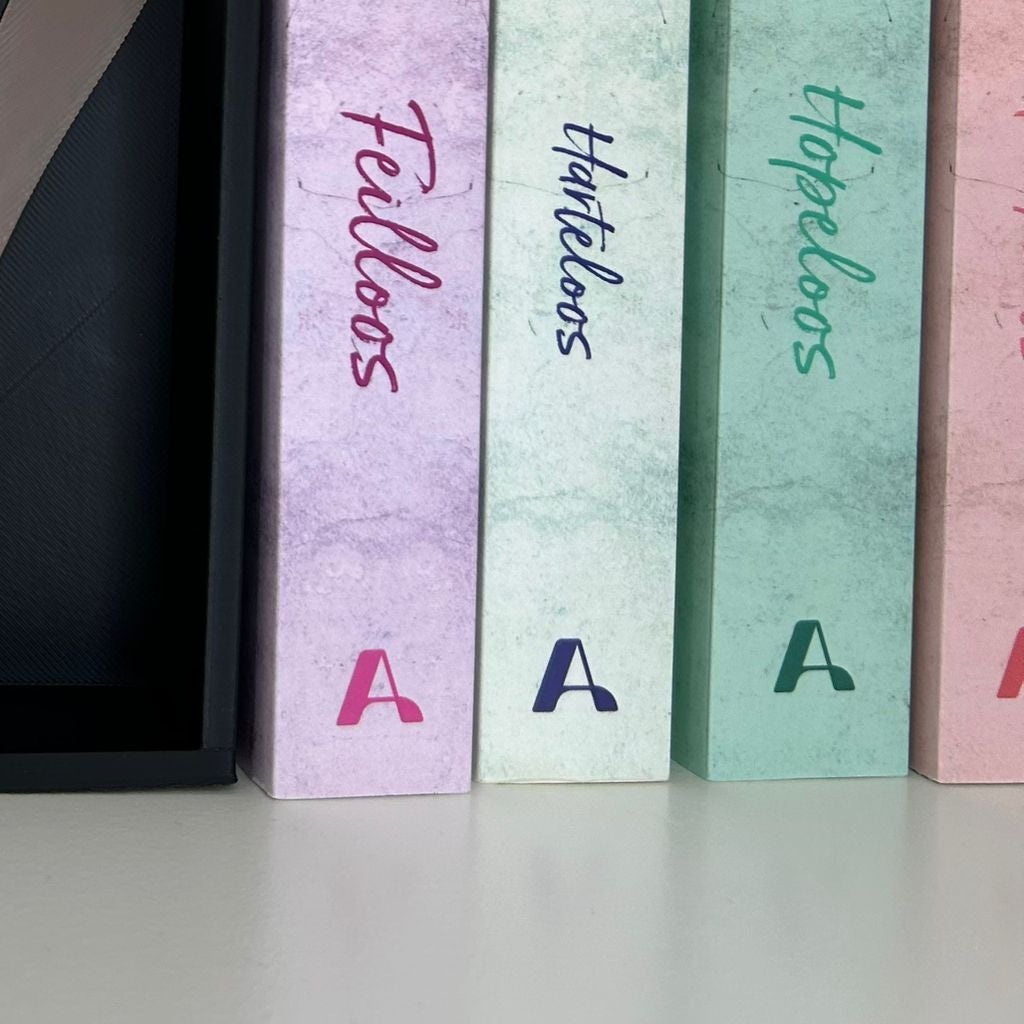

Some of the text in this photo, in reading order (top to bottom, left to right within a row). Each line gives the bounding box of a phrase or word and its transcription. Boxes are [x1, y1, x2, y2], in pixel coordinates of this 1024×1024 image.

[340, 99, 442, 393] Feilloos
[552, 123, 628, 360] Harteloos
[769, 85, 882, 379] Hopeloos
[336, 649, 423, 726] A
[532, 638, 618, 713] A
[774, 620, 855, 693] A
